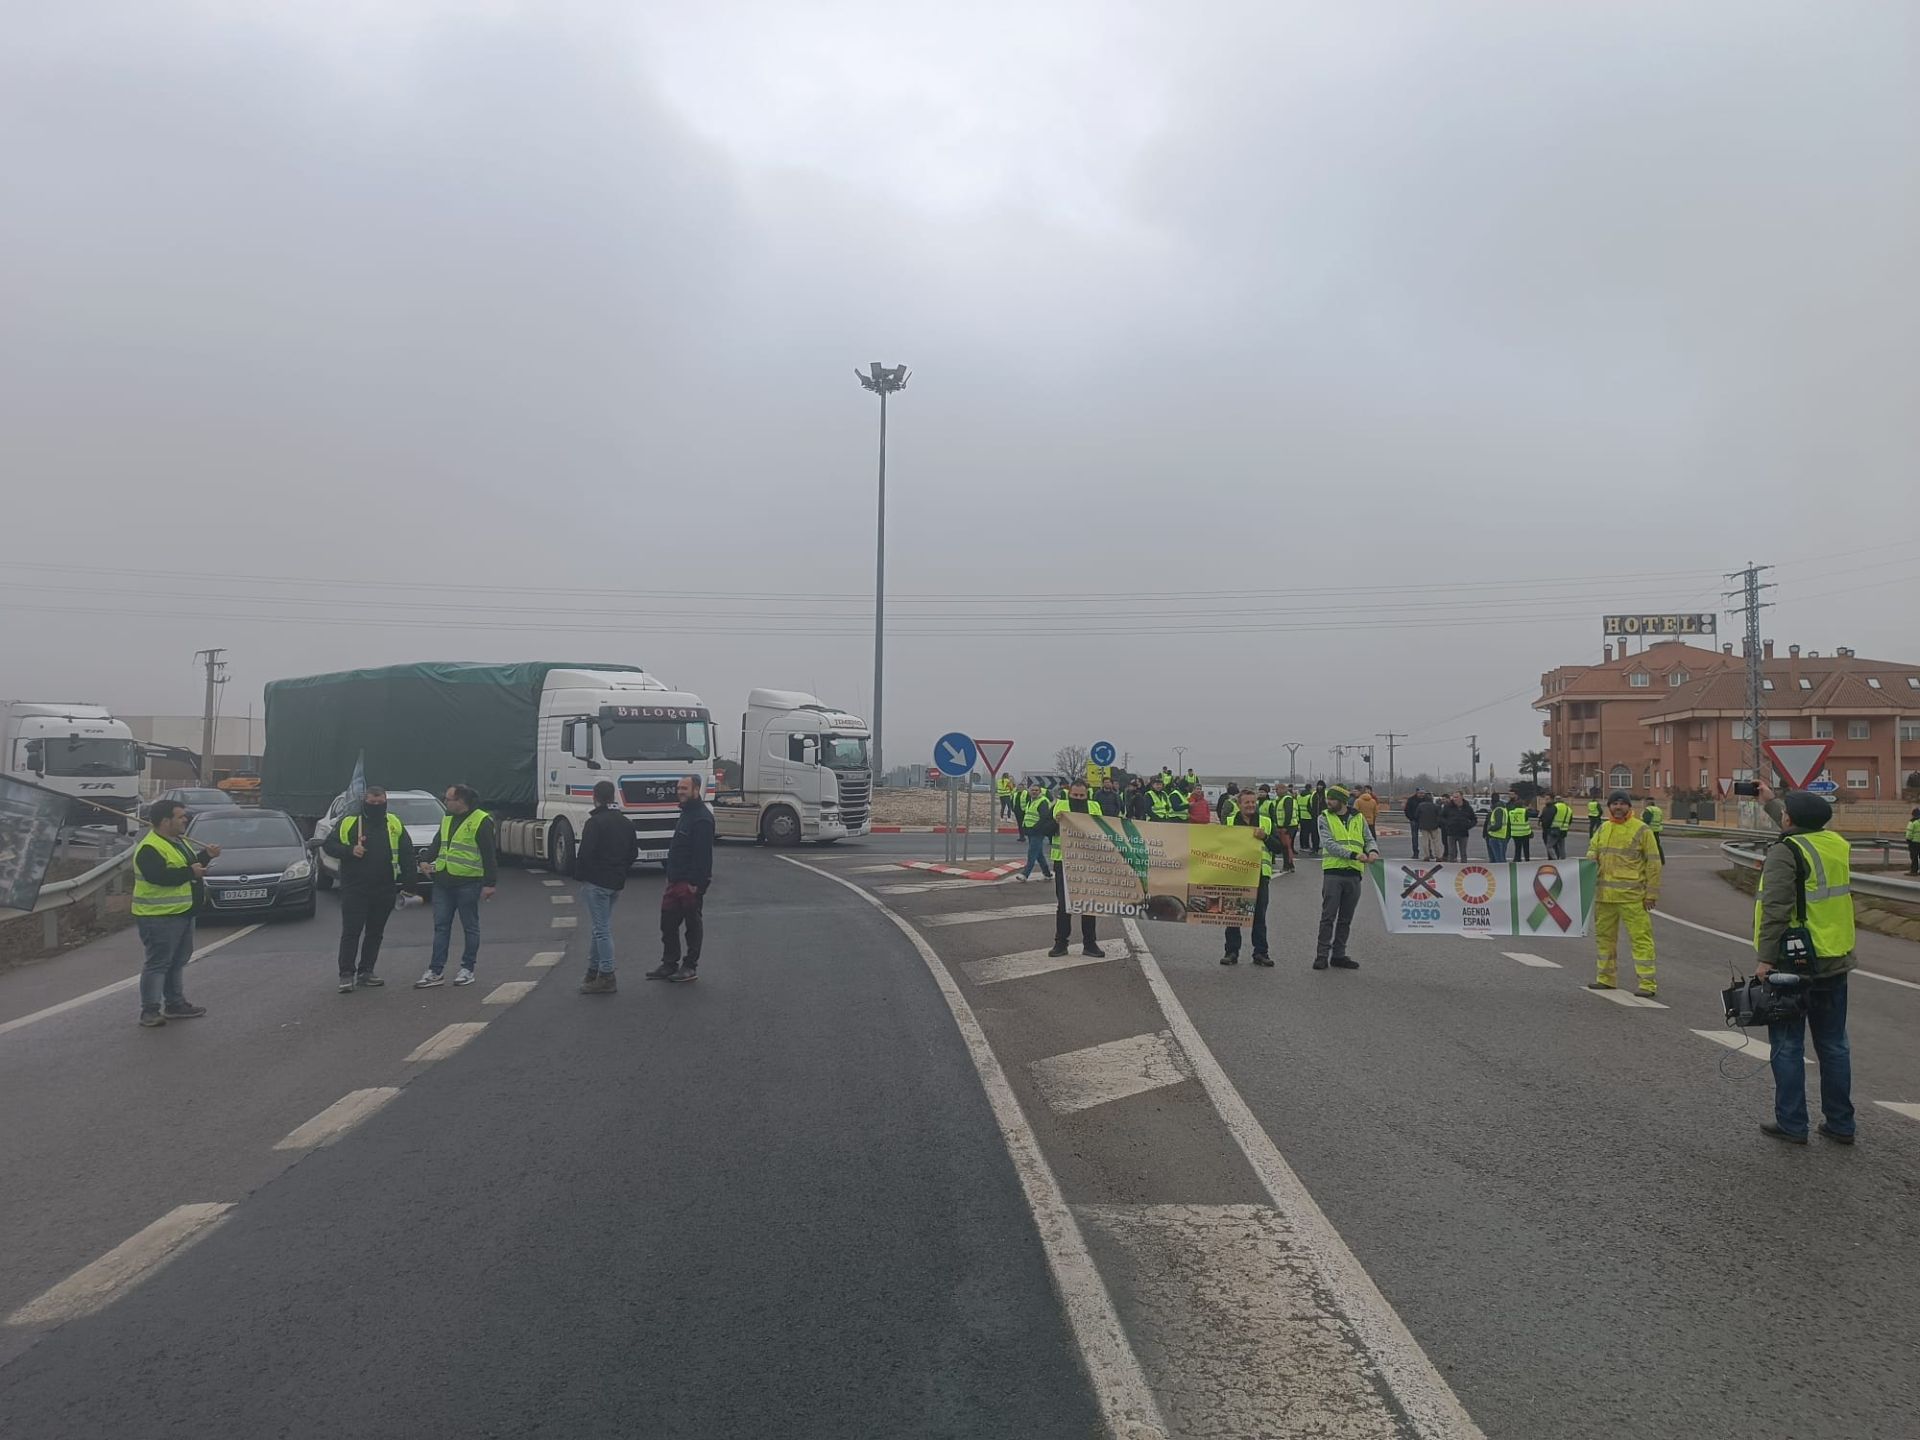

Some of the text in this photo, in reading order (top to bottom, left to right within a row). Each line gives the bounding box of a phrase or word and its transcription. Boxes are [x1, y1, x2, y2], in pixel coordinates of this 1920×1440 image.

[1606, 616, 1696, 633] HOTEL
[646, 786, 676, 795] MAN
[1127, 834, 1144, 844] vida
[1402, 908, 1440, 920] 2030
[1462, 908, 1490, 916] AGENDA
[1463, 916, 1490, 926] ESPAÑA
